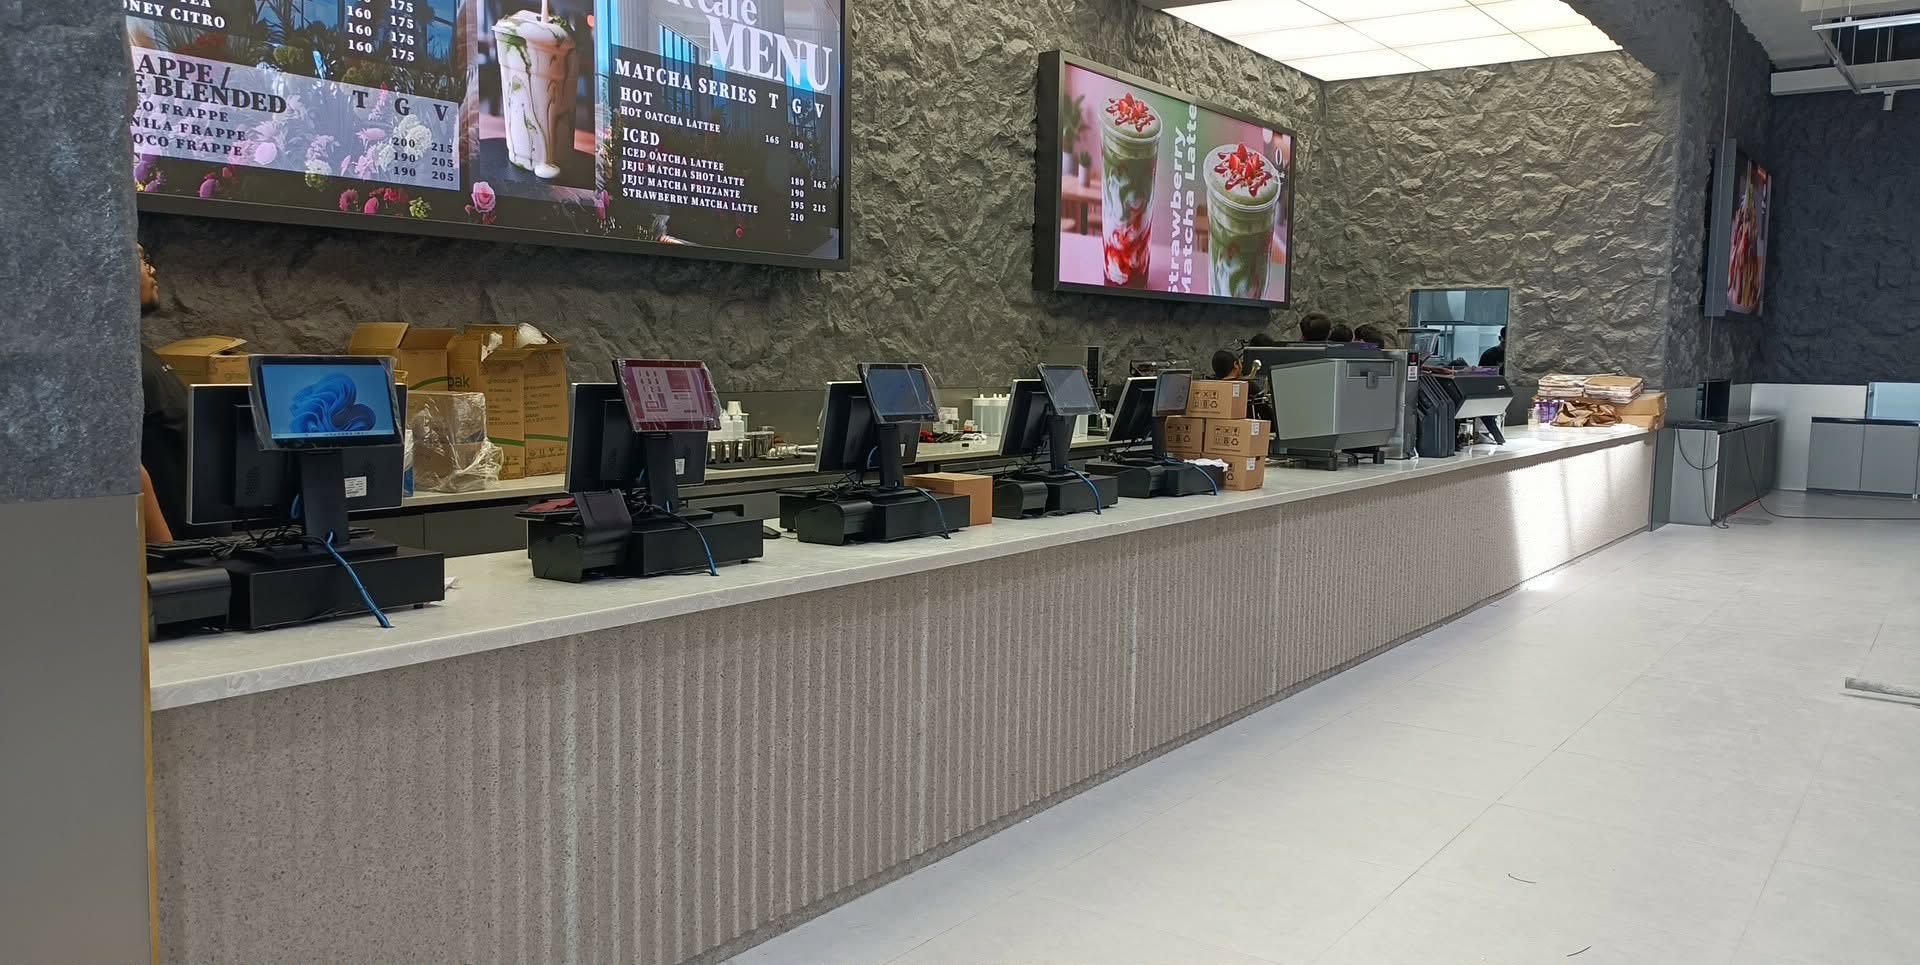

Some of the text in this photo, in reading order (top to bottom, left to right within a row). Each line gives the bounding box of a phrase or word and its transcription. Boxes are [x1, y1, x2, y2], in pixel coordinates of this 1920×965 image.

[390, 0, 413, 12] 175
[170, 8, 225, 28] CITRO
[347, 5, 414, 29] 160 175
[348, 22, 414, 46] 160 175
[348, 39, 415, 62] 160 175
[706, 14, 832, 91] MENU
[616, 58, 824, 118] MATCHA SERIES T G V
[620, 86, 652, 106] HOT
[154, 76, 286, 114] BLENDED
[352, 90, 368, 109] T
[394, 98, 410, 116] G
[434, 104, 448, 122] V
[160, 104, 229, 122] FRAPPE
[620, 106, 720, 132] HOT OATCHA LATTEE
[180, 123, 246, 140] FRAPPE
[622, 127, 660, 146] ICED
[133, 132, 242, 156] OCO FRAPPE
[392, 136, 453, 154] 200 215
[766, 134, 804, 150] 165 180
[1185, 104, 1198, 181] Latte
[394, 152, 454, 168] 190 205
[622, 146, 724, 171] ICED OATCHA LATTEE
[394, 166, 454, 182] 190 205
[622, 160, 744, 186] JEJU MATCHA SHOT LATTE
[790, 177, 826, 189] 180 165
[622, 174, 740, 198] JEJU MATCHA FRIZZANTE
[790, 188, 804, 198] 190
[622, 188, 759, 214] STRAWBERRY MATCHA LATTE
[790, 200, 826, 212] 195 215
[790, 212, 804, 222] 210
